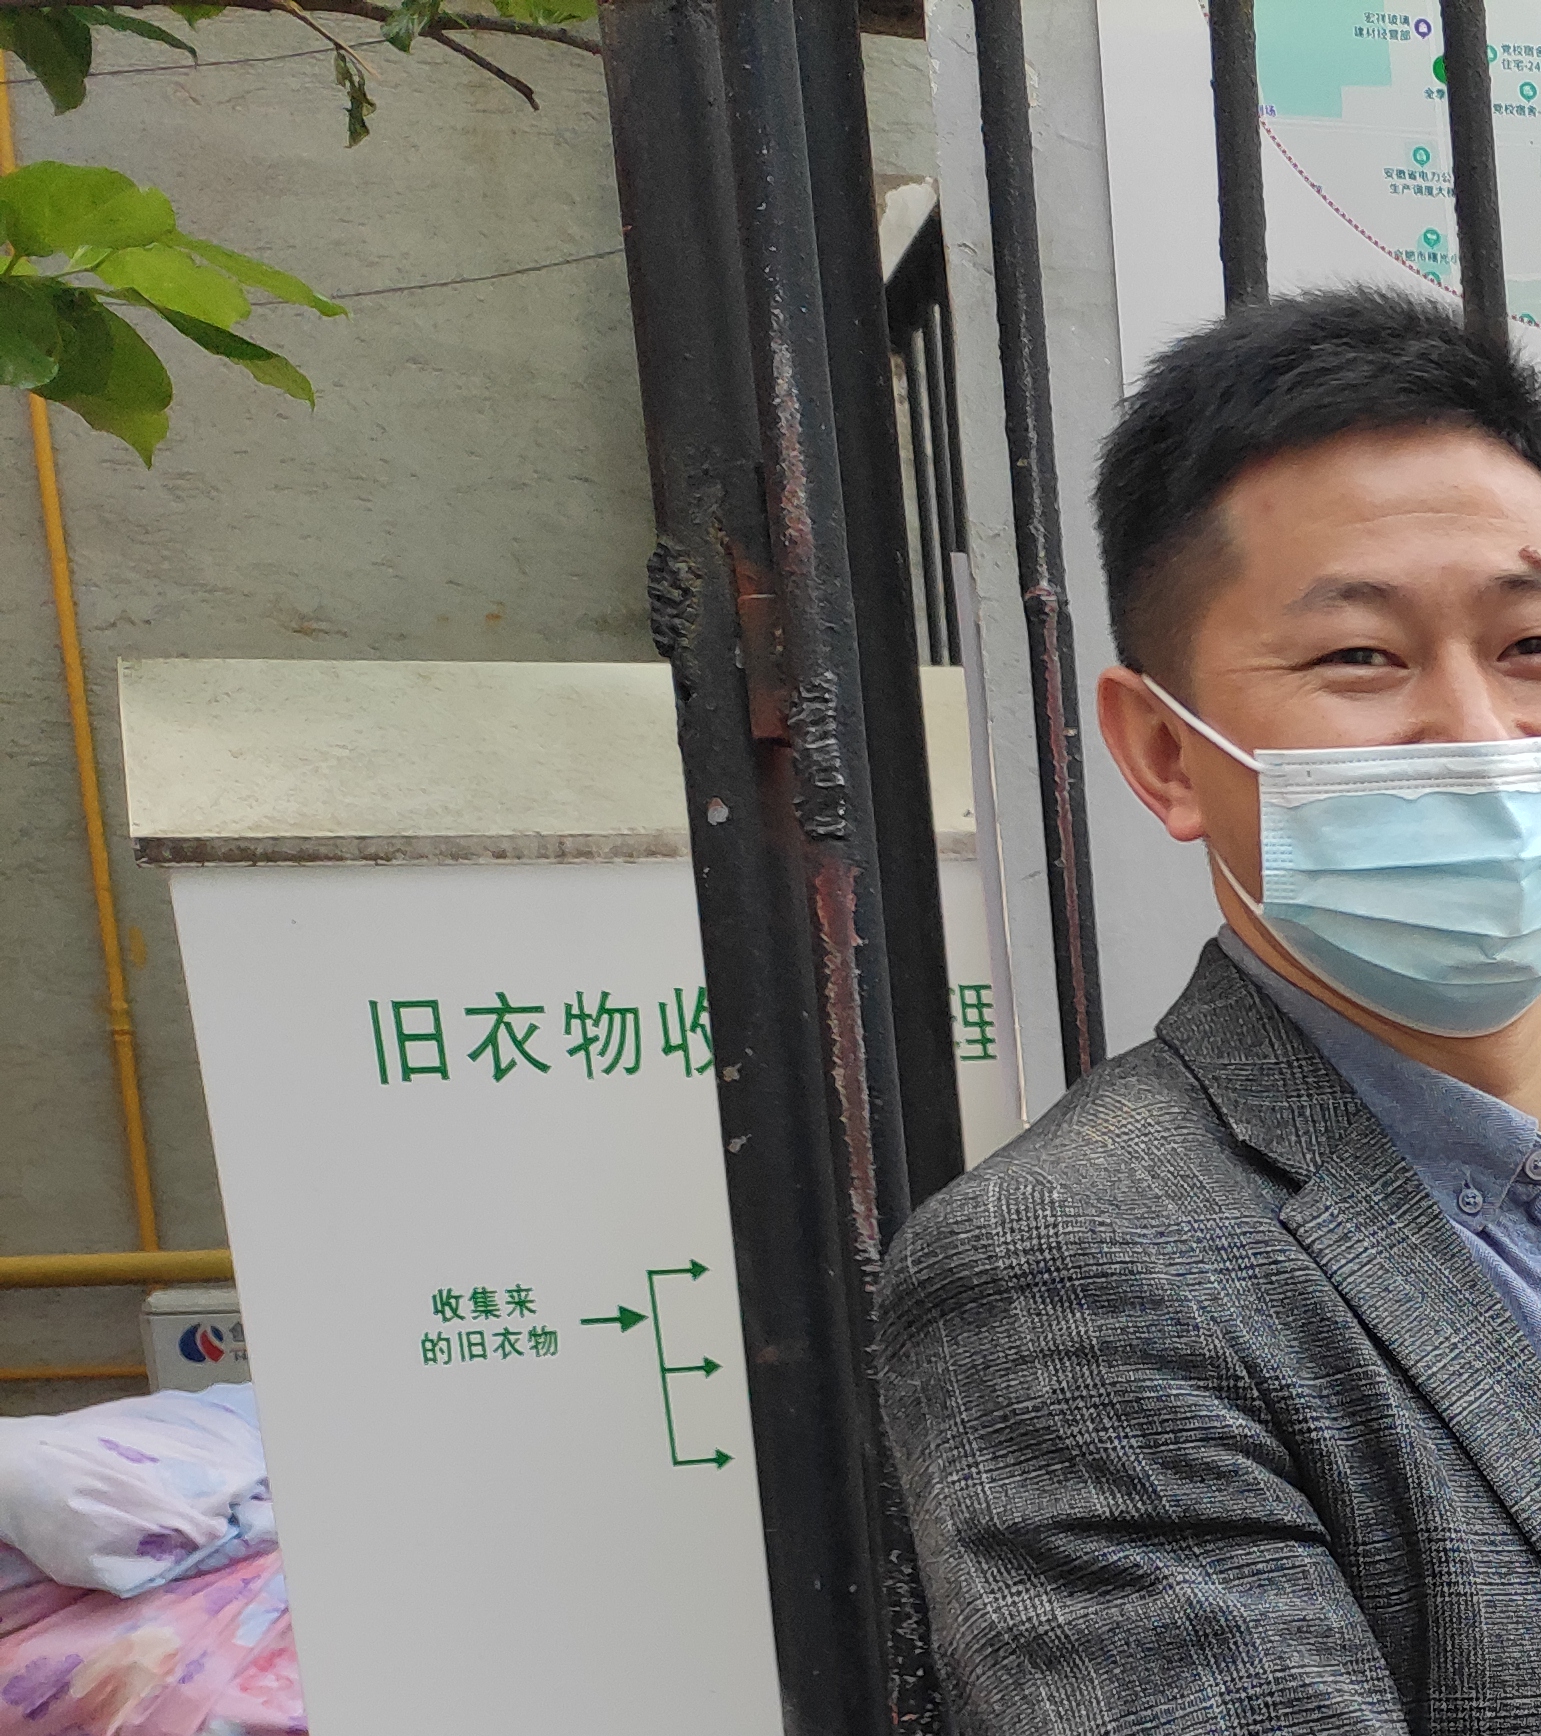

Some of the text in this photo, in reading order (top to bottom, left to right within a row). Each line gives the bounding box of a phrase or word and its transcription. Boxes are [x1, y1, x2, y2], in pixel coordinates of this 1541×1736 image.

[1383, 167, 1452, 183] 安徽省电力公
[432, 1285, 537, 1323] 收集来
[420, 1326, 559, 1366] 的旧衣物
